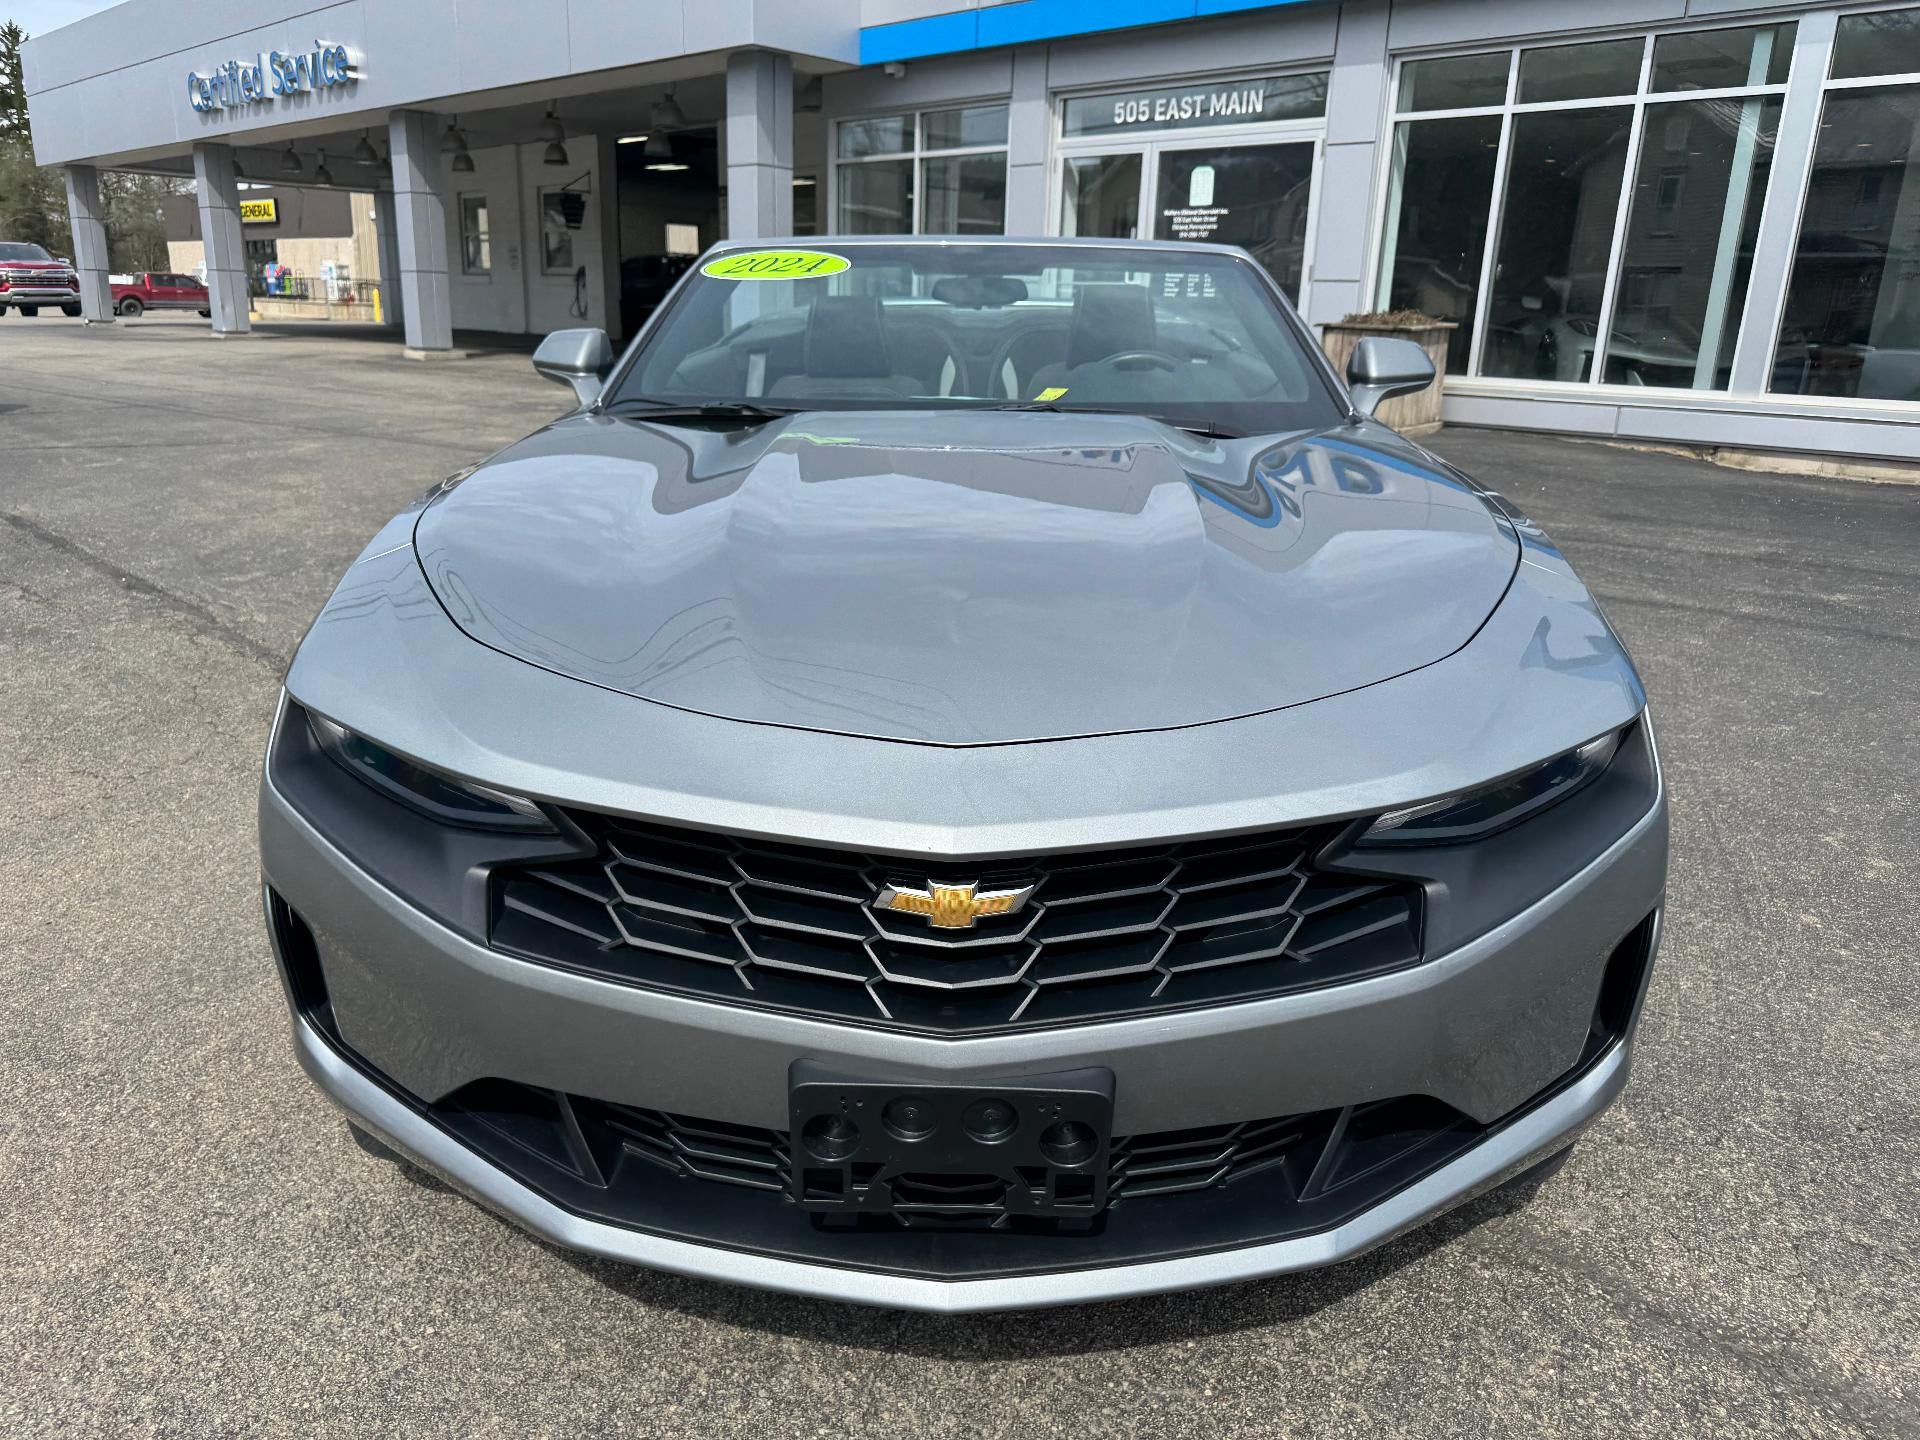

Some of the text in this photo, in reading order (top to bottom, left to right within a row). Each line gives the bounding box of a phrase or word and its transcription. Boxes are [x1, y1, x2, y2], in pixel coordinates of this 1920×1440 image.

[187, 39, 358, 113] Certified Service
[1113, 89, 1264, 124] 505 EAST MAIN
[721, 256, 830, 274] 2024
